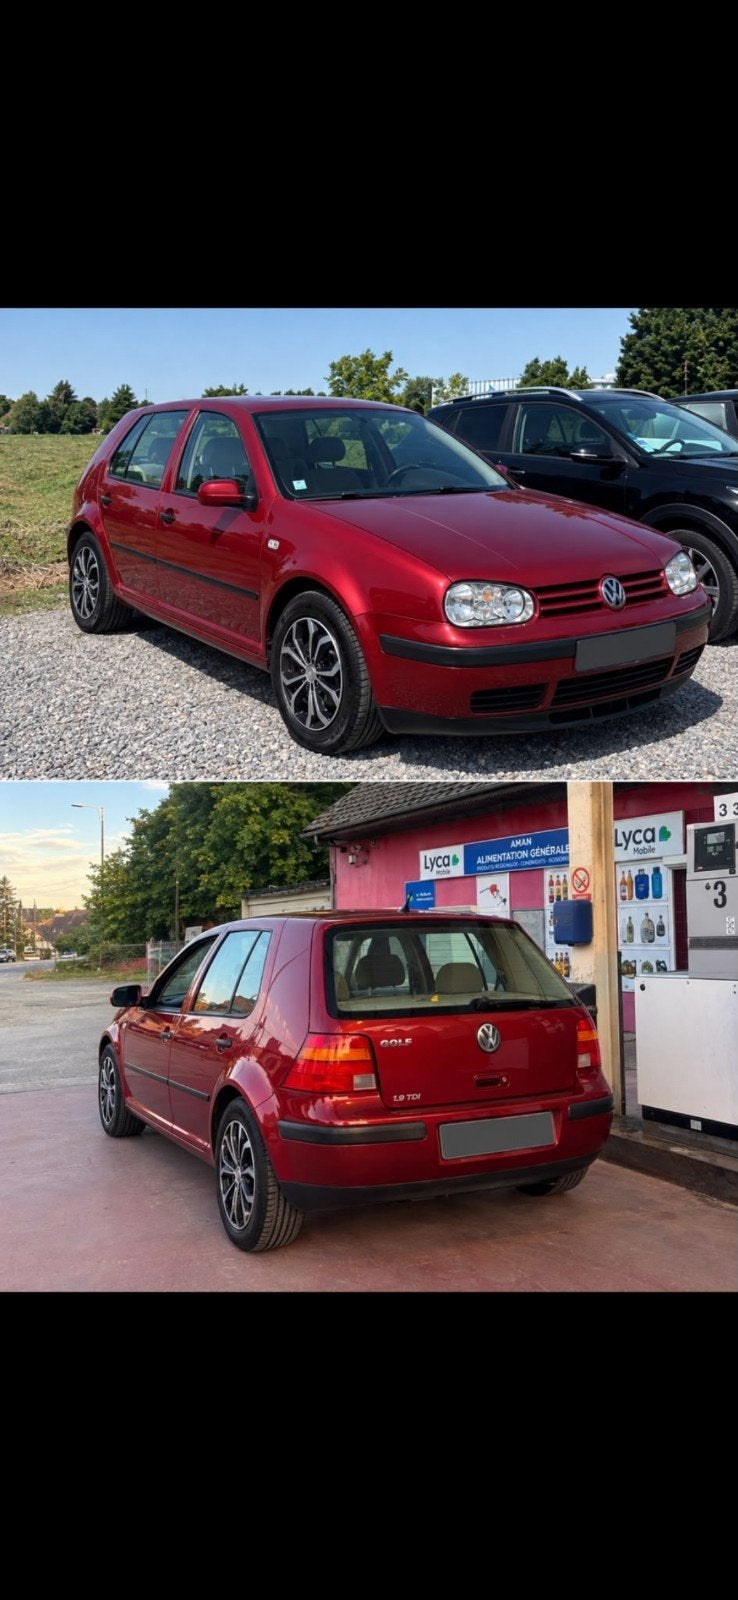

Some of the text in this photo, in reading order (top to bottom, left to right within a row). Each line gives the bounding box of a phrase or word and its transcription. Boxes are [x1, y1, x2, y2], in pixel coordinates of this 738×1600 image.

[719, 803, 728, 817] 3
[510, 837, 532, 848] AMAN
[614, 827, 656, 851] Lyca
[477, 844, 570, 864] ALIMENTATION GÉNÉRALE
[633, 845, 656, 856] Mobile
[424, 854, 451, 872] Lyca
[713, 880, 727, 909] 3
[380, 1038, 412, 1047] GOLF
[406, 1093, 421, 1101] TDI
